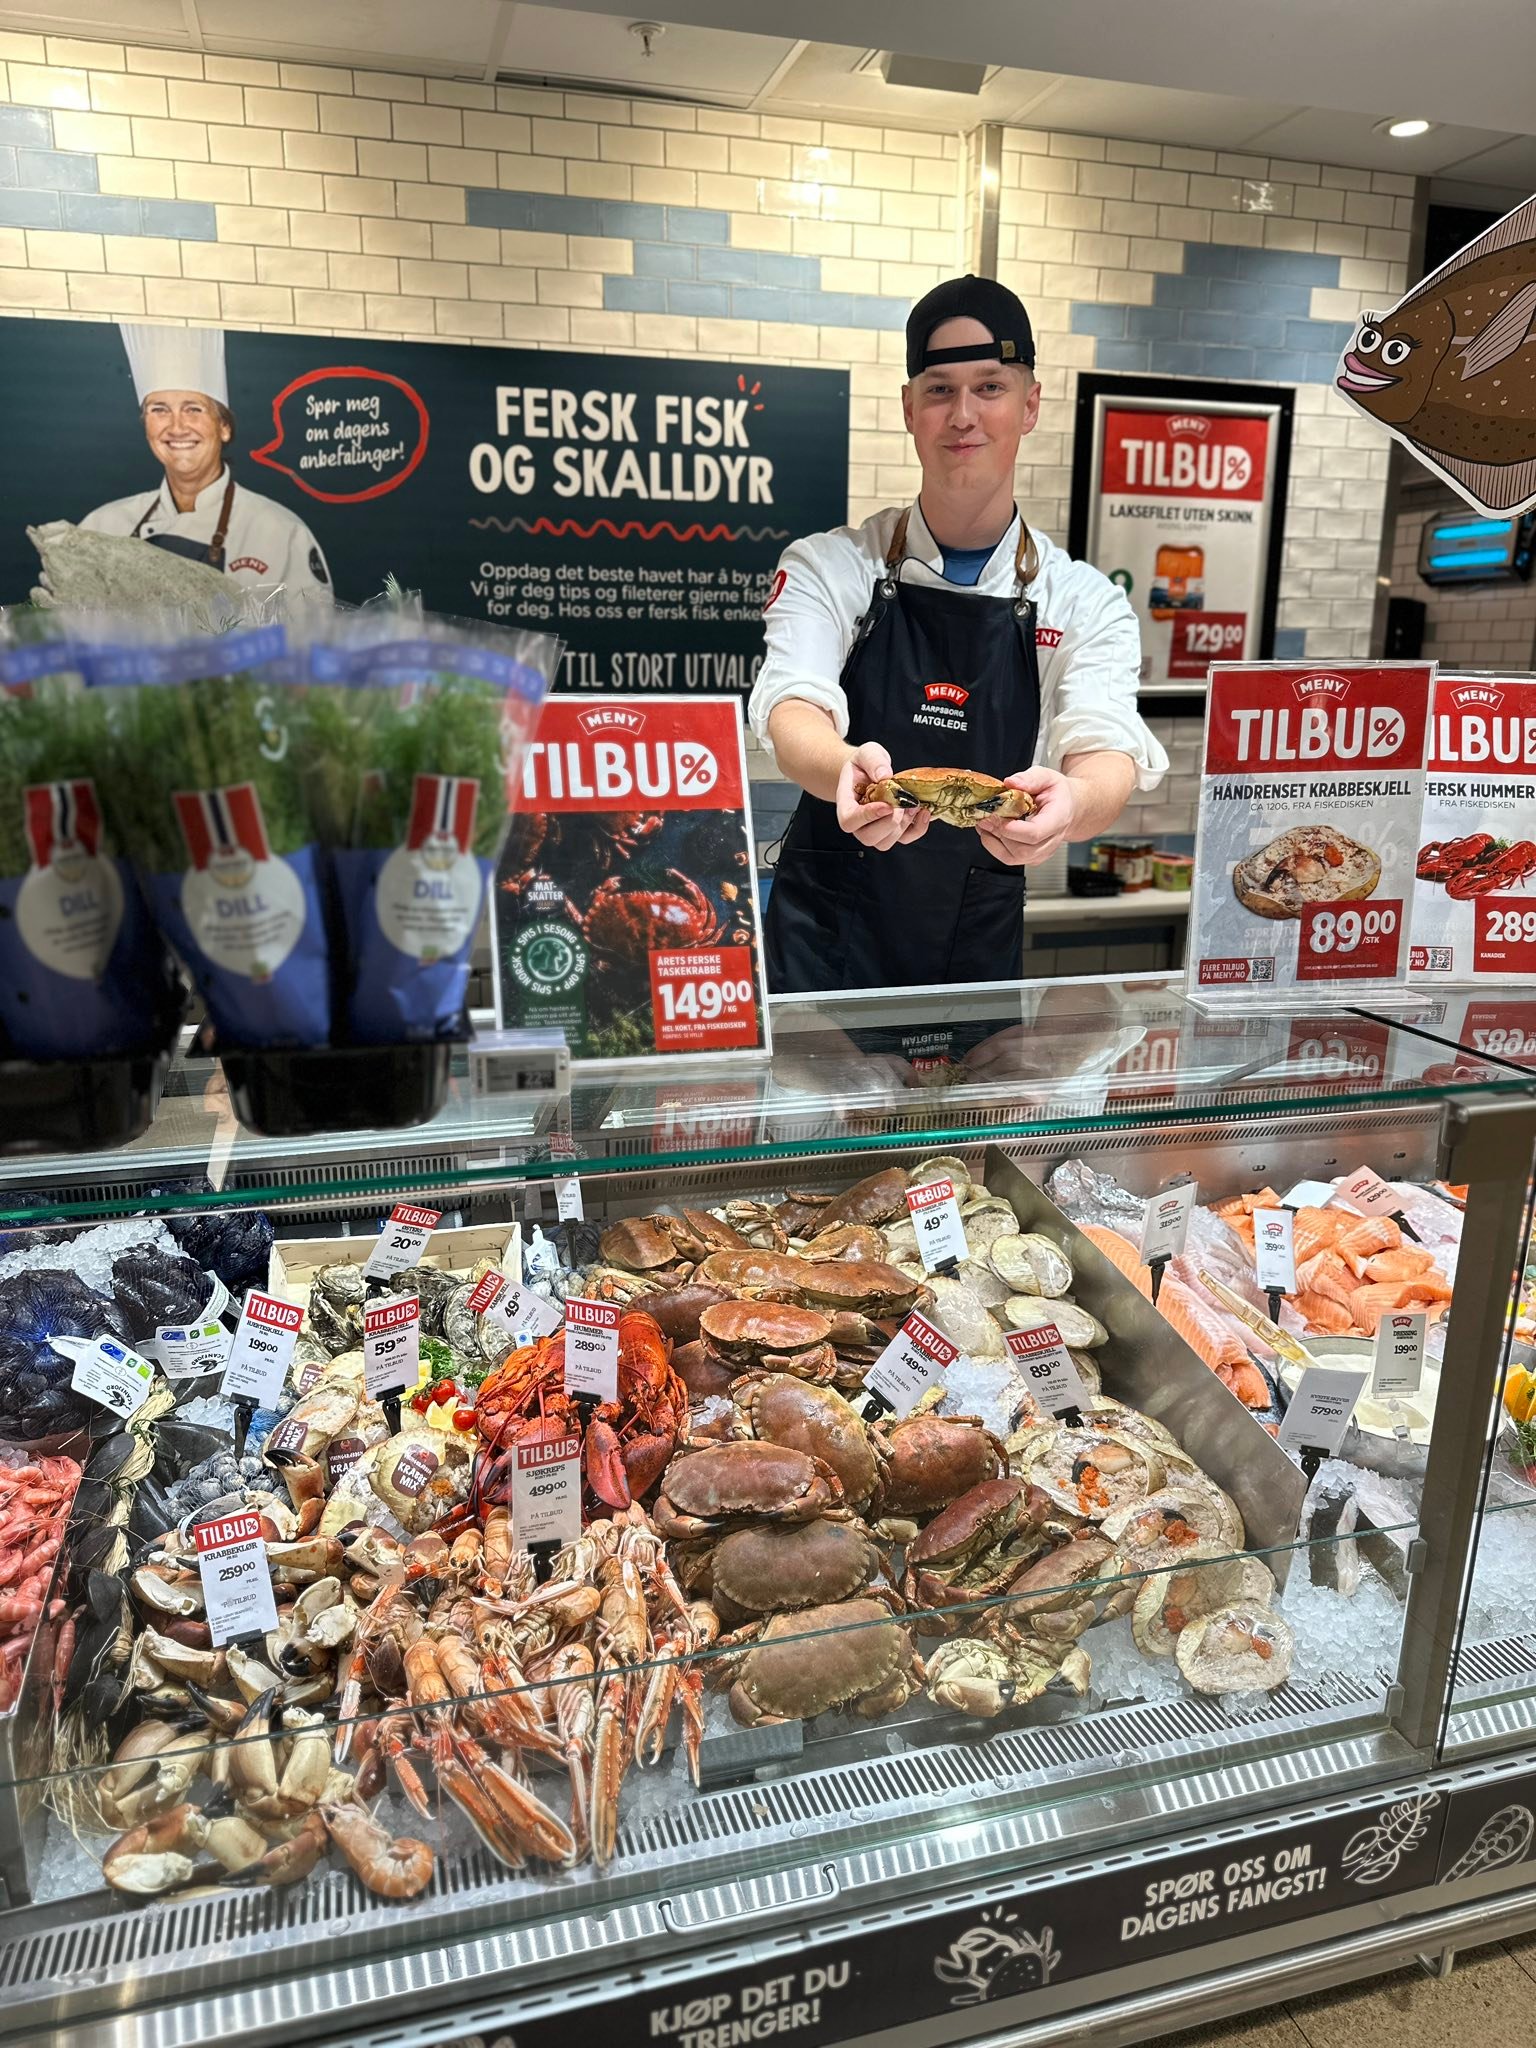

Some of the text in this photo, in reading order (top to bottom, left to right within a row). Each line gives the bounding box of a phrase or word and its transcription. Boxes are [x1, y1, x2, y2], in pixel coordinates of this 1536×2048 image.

[306, 394, 380, 420] Spør meg
[495, 386, 750, 448] FERSK FISK
[306, 420, 390, 450] om dagens
[1171, 417, 1206, 433] MENY
[300, 440, 405, 472] anbefalinger!
[1120, 438, 1252, 491] TILBUD
[469, 444, 774, 504] OG SKALLDYR
[1109, 504, 1254, 524] LAKSEFILET UTEN SKINN
[480, 562, 551, 582] Oppdag
[555, 563, 584, 581] det
[588, 564, 635, 582] beste
[638, 566, 683, 583] havet
[688, 567, 713, 584] har
[718, 566, 728, 585] å
[732, 568, 752, 589] by
[470, 581, 488, 597] Vi
[493, 582, 516, 601] gir
[521, 582, 555, 601] deg
[559, 584, 591, 602] tips
[595, 586, 617, 603] og
[622, 585, 683, 602] fileterer
[689, 586, 739, 605] gjerne
[487, 600, 511, 616] for
[516, 600, 554, 619] deg.
[559, 603, 590, 618] Hos
[595, 605, 623, 618] oss
[627, 606, 645, 619] er
[648, 604, 688, 620] fersk
[692, 605, 719, 620] fisk
[562, 652, 604, 687] TIL
[611, 653, 677, 688] STORT
[929, 686, 965, 702] MENY
[1300, 678, 1344, 695] MENY
[1457, 690, 1498, 704] MENY
[586, 710, 639, 730] MENY
[920, 703, 965, 718] SARPSBORG
[913, 713, 968, 732] MATGLEDE
[1231, 706, 1405, 761] TILBUD
[1213, 780, 1412, 802] HÅNDRENSET KRABBESKJELL
[1470, 783, 1536, 799] HUMMER
[1250, 800, 1374, 812] CA 120G, FRA FISKEDISKEN
[1439, 799, 1516, 809] FRA FISKEDISKEN
[412, 880, 454, 900] DILL
[527, 891, 564, 901] SKATTER
[534, 881, 557, 891] MAT-
[59, 892, 99, 917] DILL
[216, 894, 269, 919] DILL
[517, 927, 537, 947] SPIS
[543, 923, 578, 944] SESONG
[657, 954, 721, 967] ÅRETS FERSKE
[1202, 962, 1246, 972] FLERE TILBUD
[511, 955, 552, 995] SPIS NORSK
[563, 953, 586, 990] SPIS OPP
[657, 966, 722, 977] TASKEKRABBE
[1202, 971, 1246, 980] PÅ MENY.NO
[694, 1023, 706, 1031] FRA
[707, 1021, 746, 1030] FISKEDISKEN
[395, 1206, 438, 1226] TILBUD
[470, 1274, 499, 1310] TILBUD
[250, 1298, 299, 1326] TILBUD
[366, 1303, 417, 1329] TILBUD
[567, 1303, 616, 1325] TILBUD
[1394, 1317, 1411, 1326] MENY
[246, 1319, 285, 1337] HJERTESKJELL
[573, 1324, 604, 1335] HUMMER
[907, 1317, 952, 1361] TILBUD
[1008, 1328, 1060, 1351] TILBUD
[520, 1439, 579, 1465] TILBUD
[397, 1461, 428, 1486] KRABBE
[526, 1464, 566, 1478] SJØKREPS
[399, 1474, 419, 1491] MIX
[530, 1509, 563, 1520] PÅ TILBUD
[199, 1517, 259, 1546] TILBUD
[204, 1542, 258, 1562] KRABBEKLØR
[234, 1593, 257, 1605] TILBUD
[1145, 1844, 1313, 1908] SPØR OSS OM
[1120, 1867, 1328, 1943] DAGENS FANGST!
[651, 1961, 850, 2037] KJØP DET DU
[678, 1998, 821, 2048] TRENGER!
